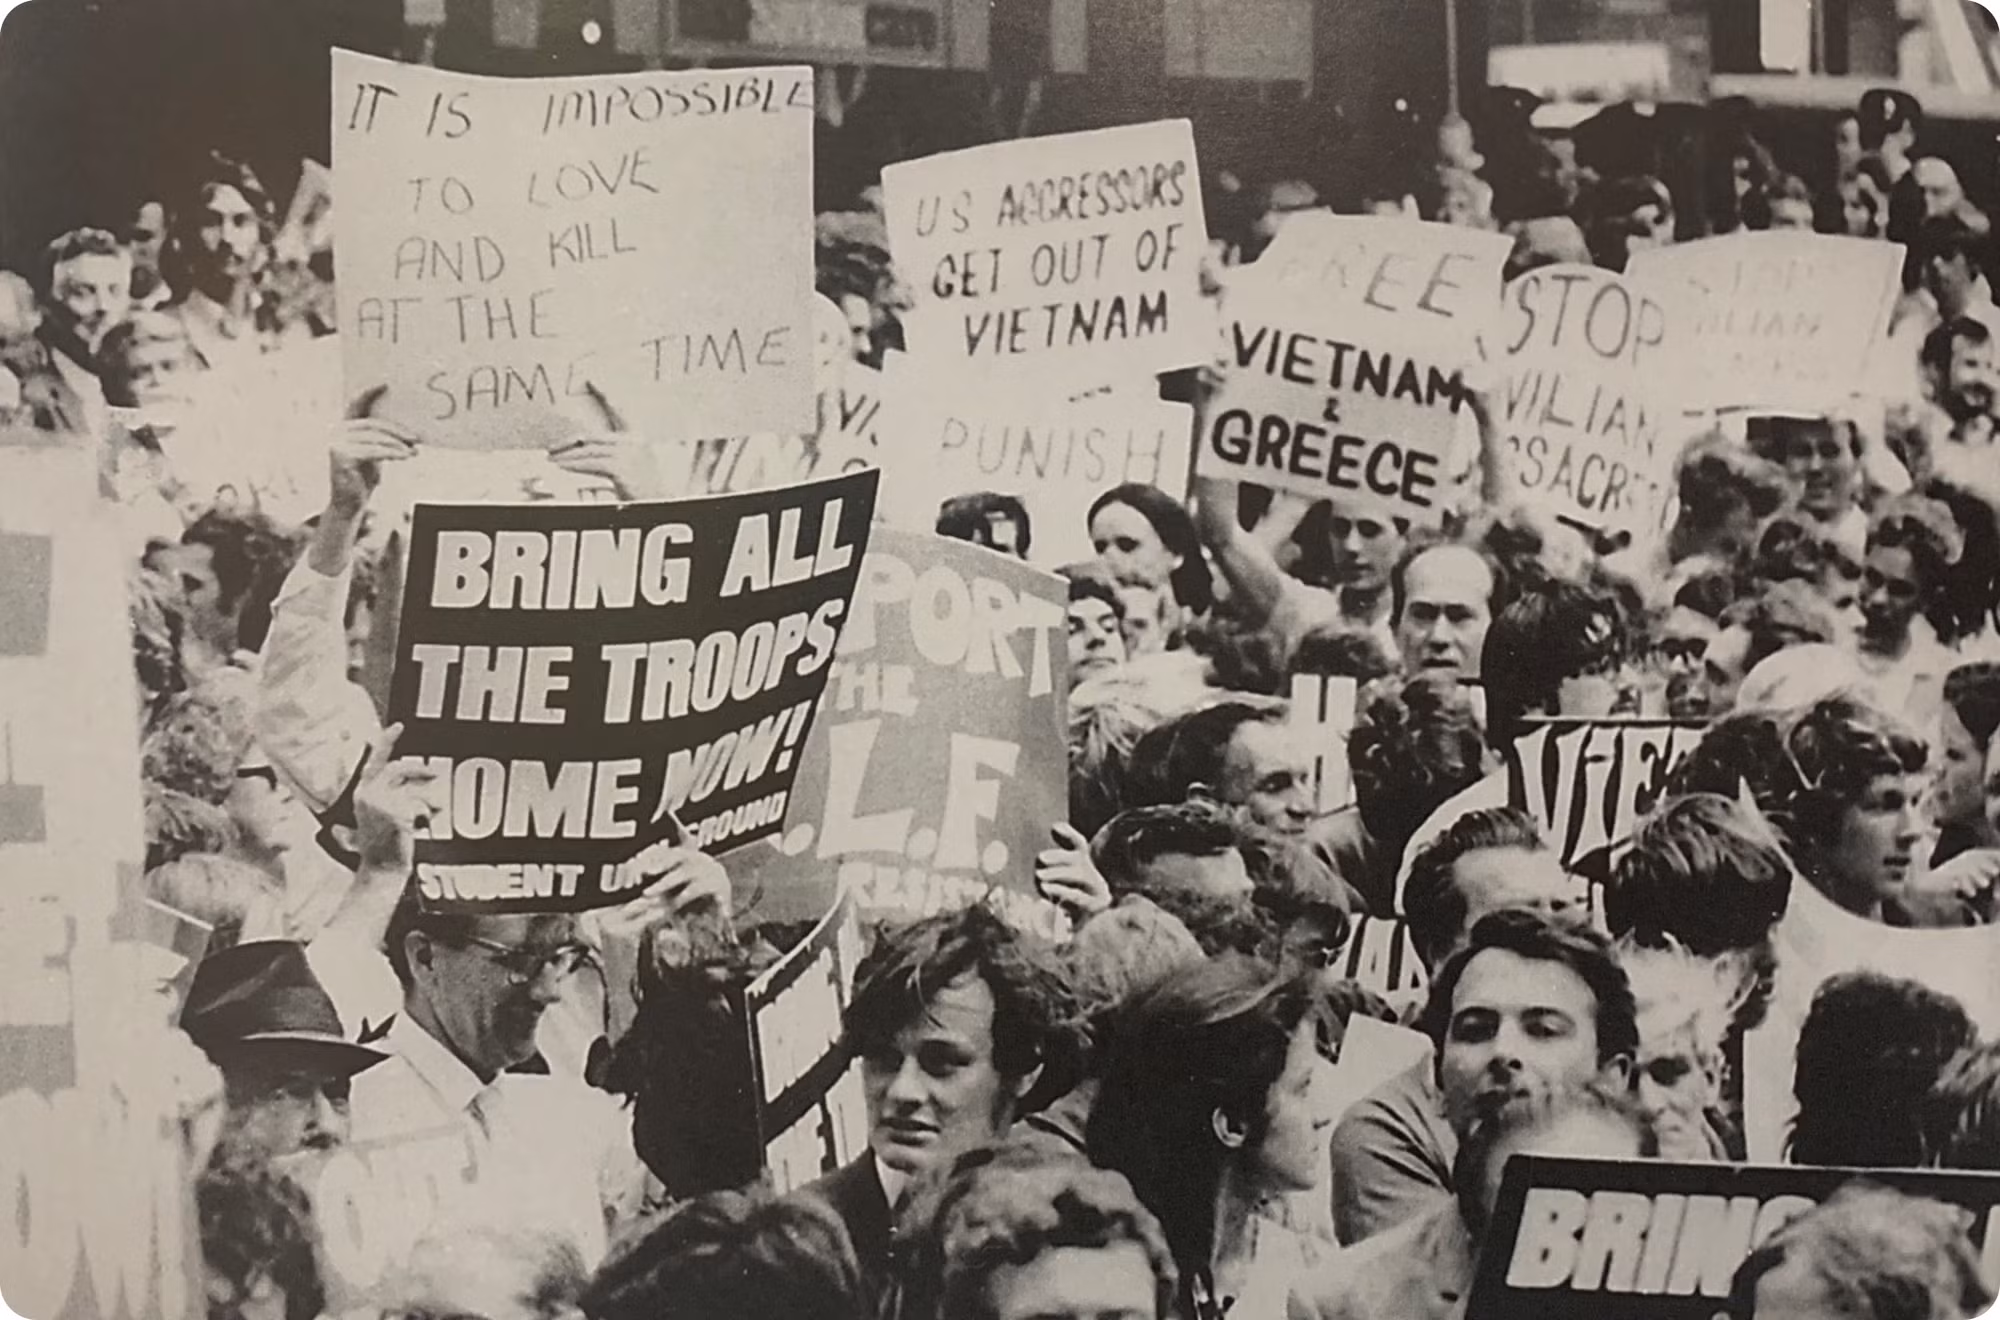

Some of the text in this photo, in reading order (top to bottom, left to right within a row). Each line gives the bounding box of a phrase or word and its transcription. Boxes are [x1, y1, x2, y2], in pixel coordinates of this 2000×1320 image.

[349, 77, 814, 138] IT IS IMPOSSIBLE
[409, 150, 661, 214] TO LOVE
[997, 159, 1186, 229] AGGRESSORS
[395, 218, 638, 283] AND KILL
[933, 222, 1184, 300] GET OUT OF
[358, 289, 557, 345] AT THE
[965, 289, 1168, 358] VIETNAM
[1506, 272, 1667, 369] STOP
[641, 326, 792, 382] TIME
[1233, 321, 1463, 415] VIETNAM
[1506, 367, 1660, 458] VILIAN
[936, 416, 1166, 484] PUNISH
[1212, 408, 1440, 508] GREECE
[431, 498, 854, 610] BRING ALL
[834, 552, 1066, 698] PORT
[412, 598, 845, 724] THE TROOPS
[416, 862, 586, 900] STUDENT
